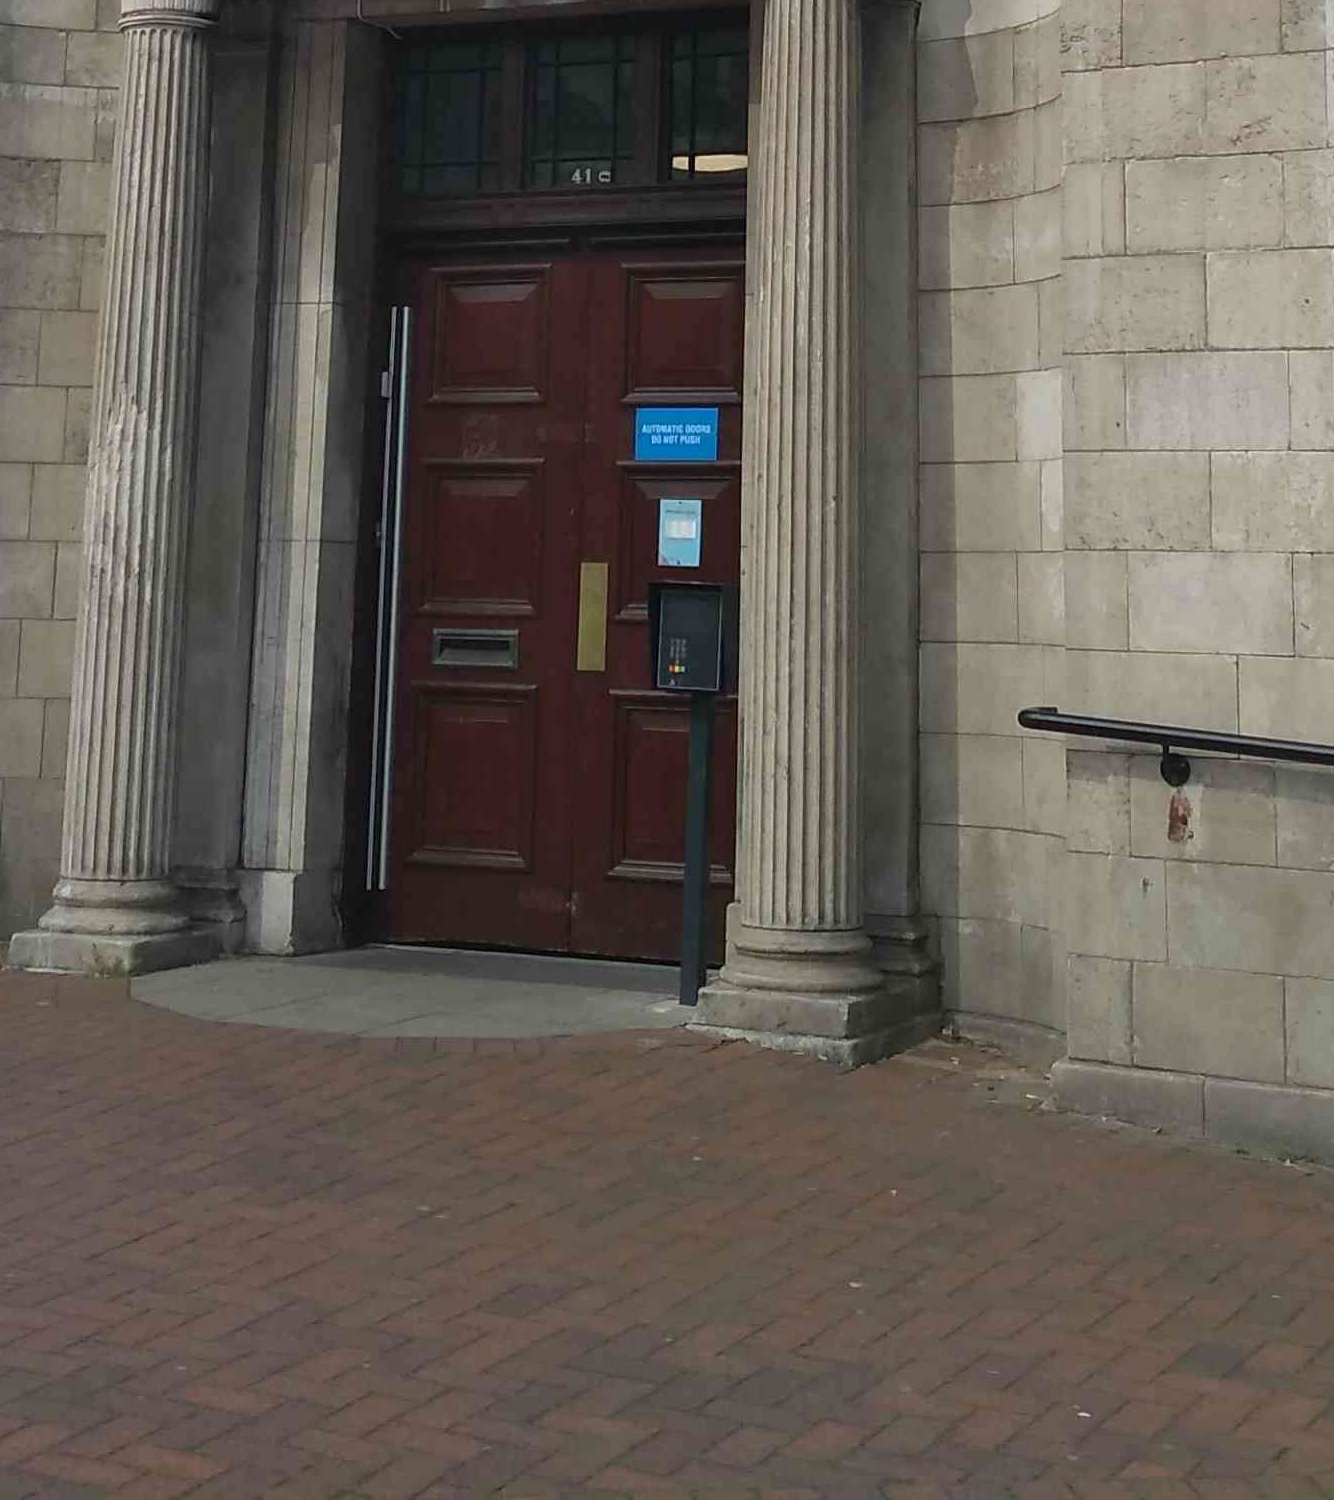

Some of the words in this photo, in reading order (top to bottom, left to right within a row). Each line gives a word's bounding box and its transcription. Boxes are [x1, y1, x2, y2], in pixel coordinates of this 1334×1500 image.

[642, 424, 684, 434] AUTOMATIC
[685, 424, 711, 434] DOORS
[651, 435, 662, 445] DO
[663, 435, 678, 445] NOT
[680, 435, 701, 445] PUSH
